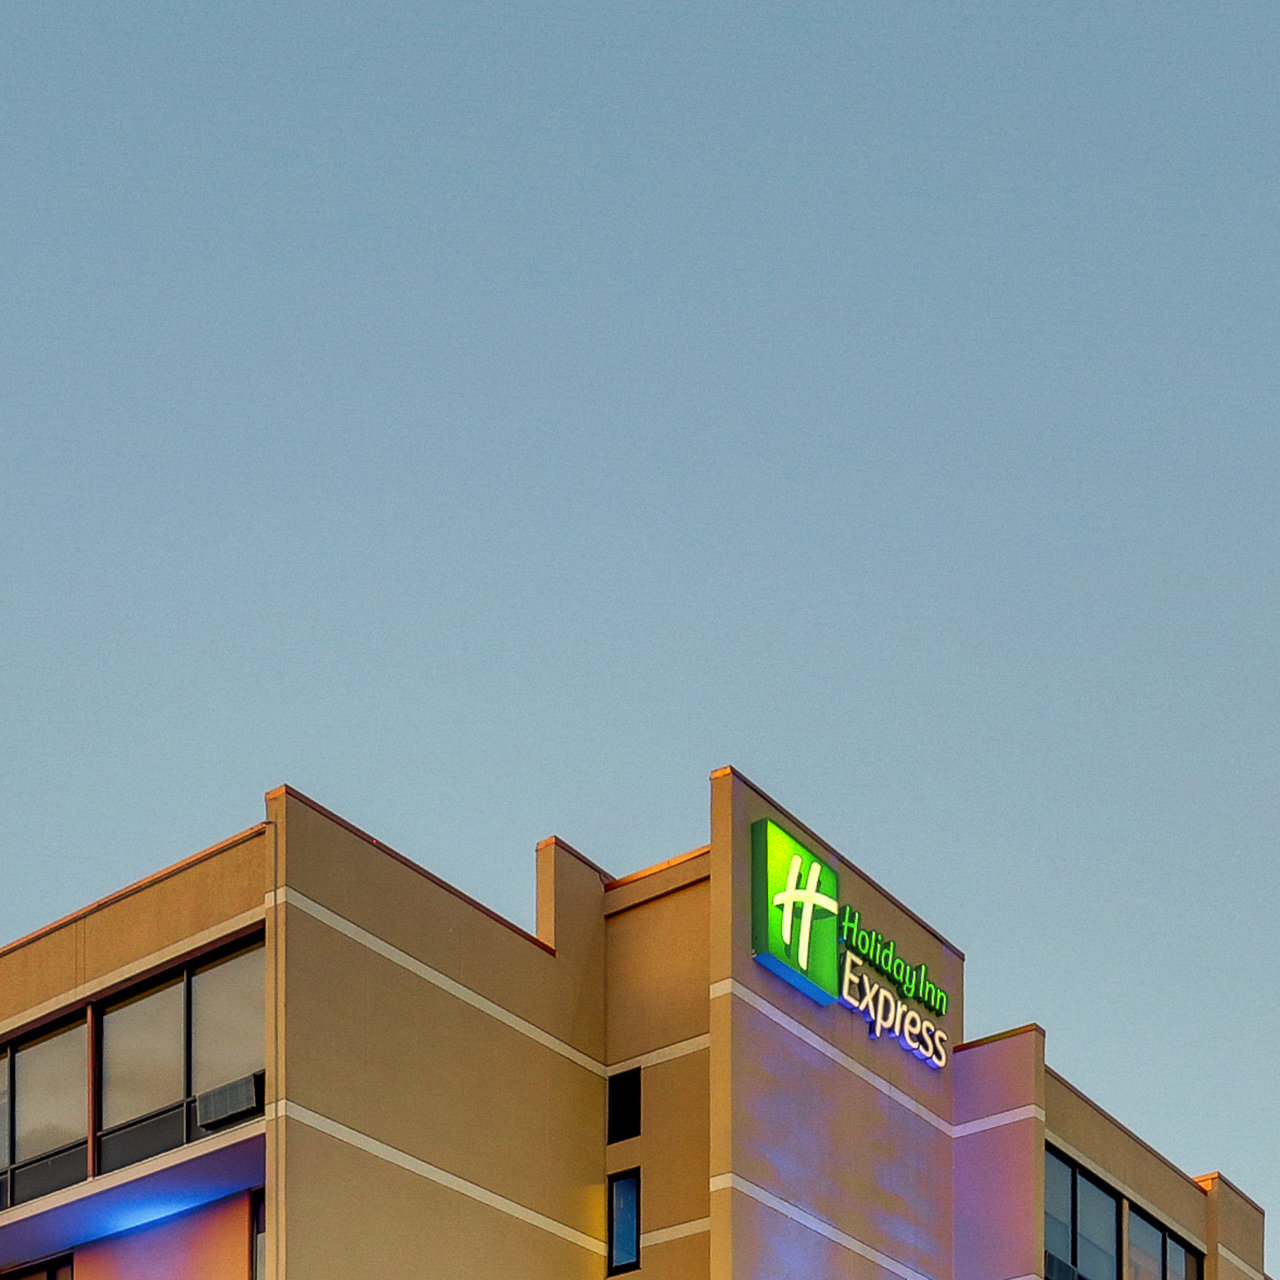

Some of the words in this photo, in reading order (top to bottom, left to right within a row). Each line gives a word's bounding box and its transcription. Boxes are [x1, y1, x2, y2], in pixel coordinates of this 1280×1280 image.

[841, 904, 917, 998] Holiday
[919, 963, 948, 1016] Inn
[842, 949, 949, 1069] Express
